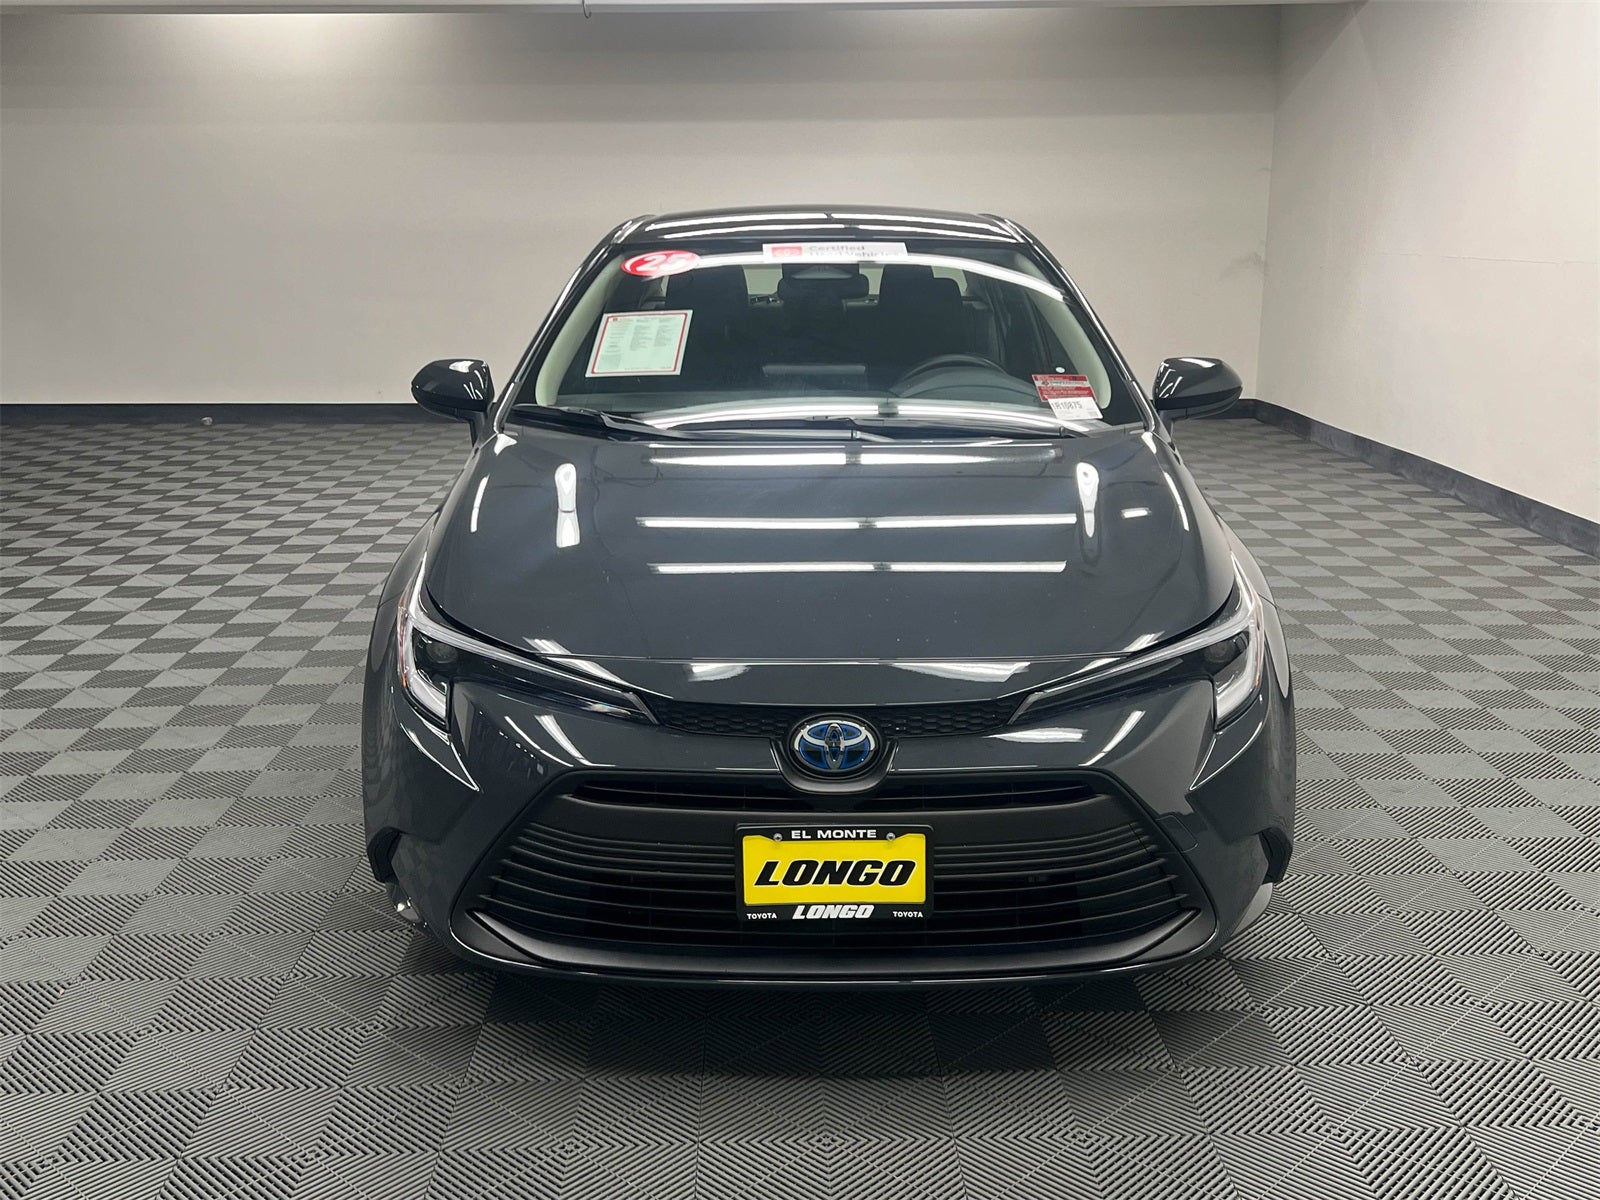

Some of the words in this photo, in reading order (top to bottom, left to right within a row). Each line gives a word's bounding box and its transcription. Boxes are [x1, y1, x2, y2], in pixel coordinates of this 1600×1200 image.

[635, 253, 691, 273] 25
[791, 830, 811, 839] EL
[817, 829, 877, 839] MONTE
[754, 860, 917, 887] LONGO
[792, 905, 875, 919] LONGO
